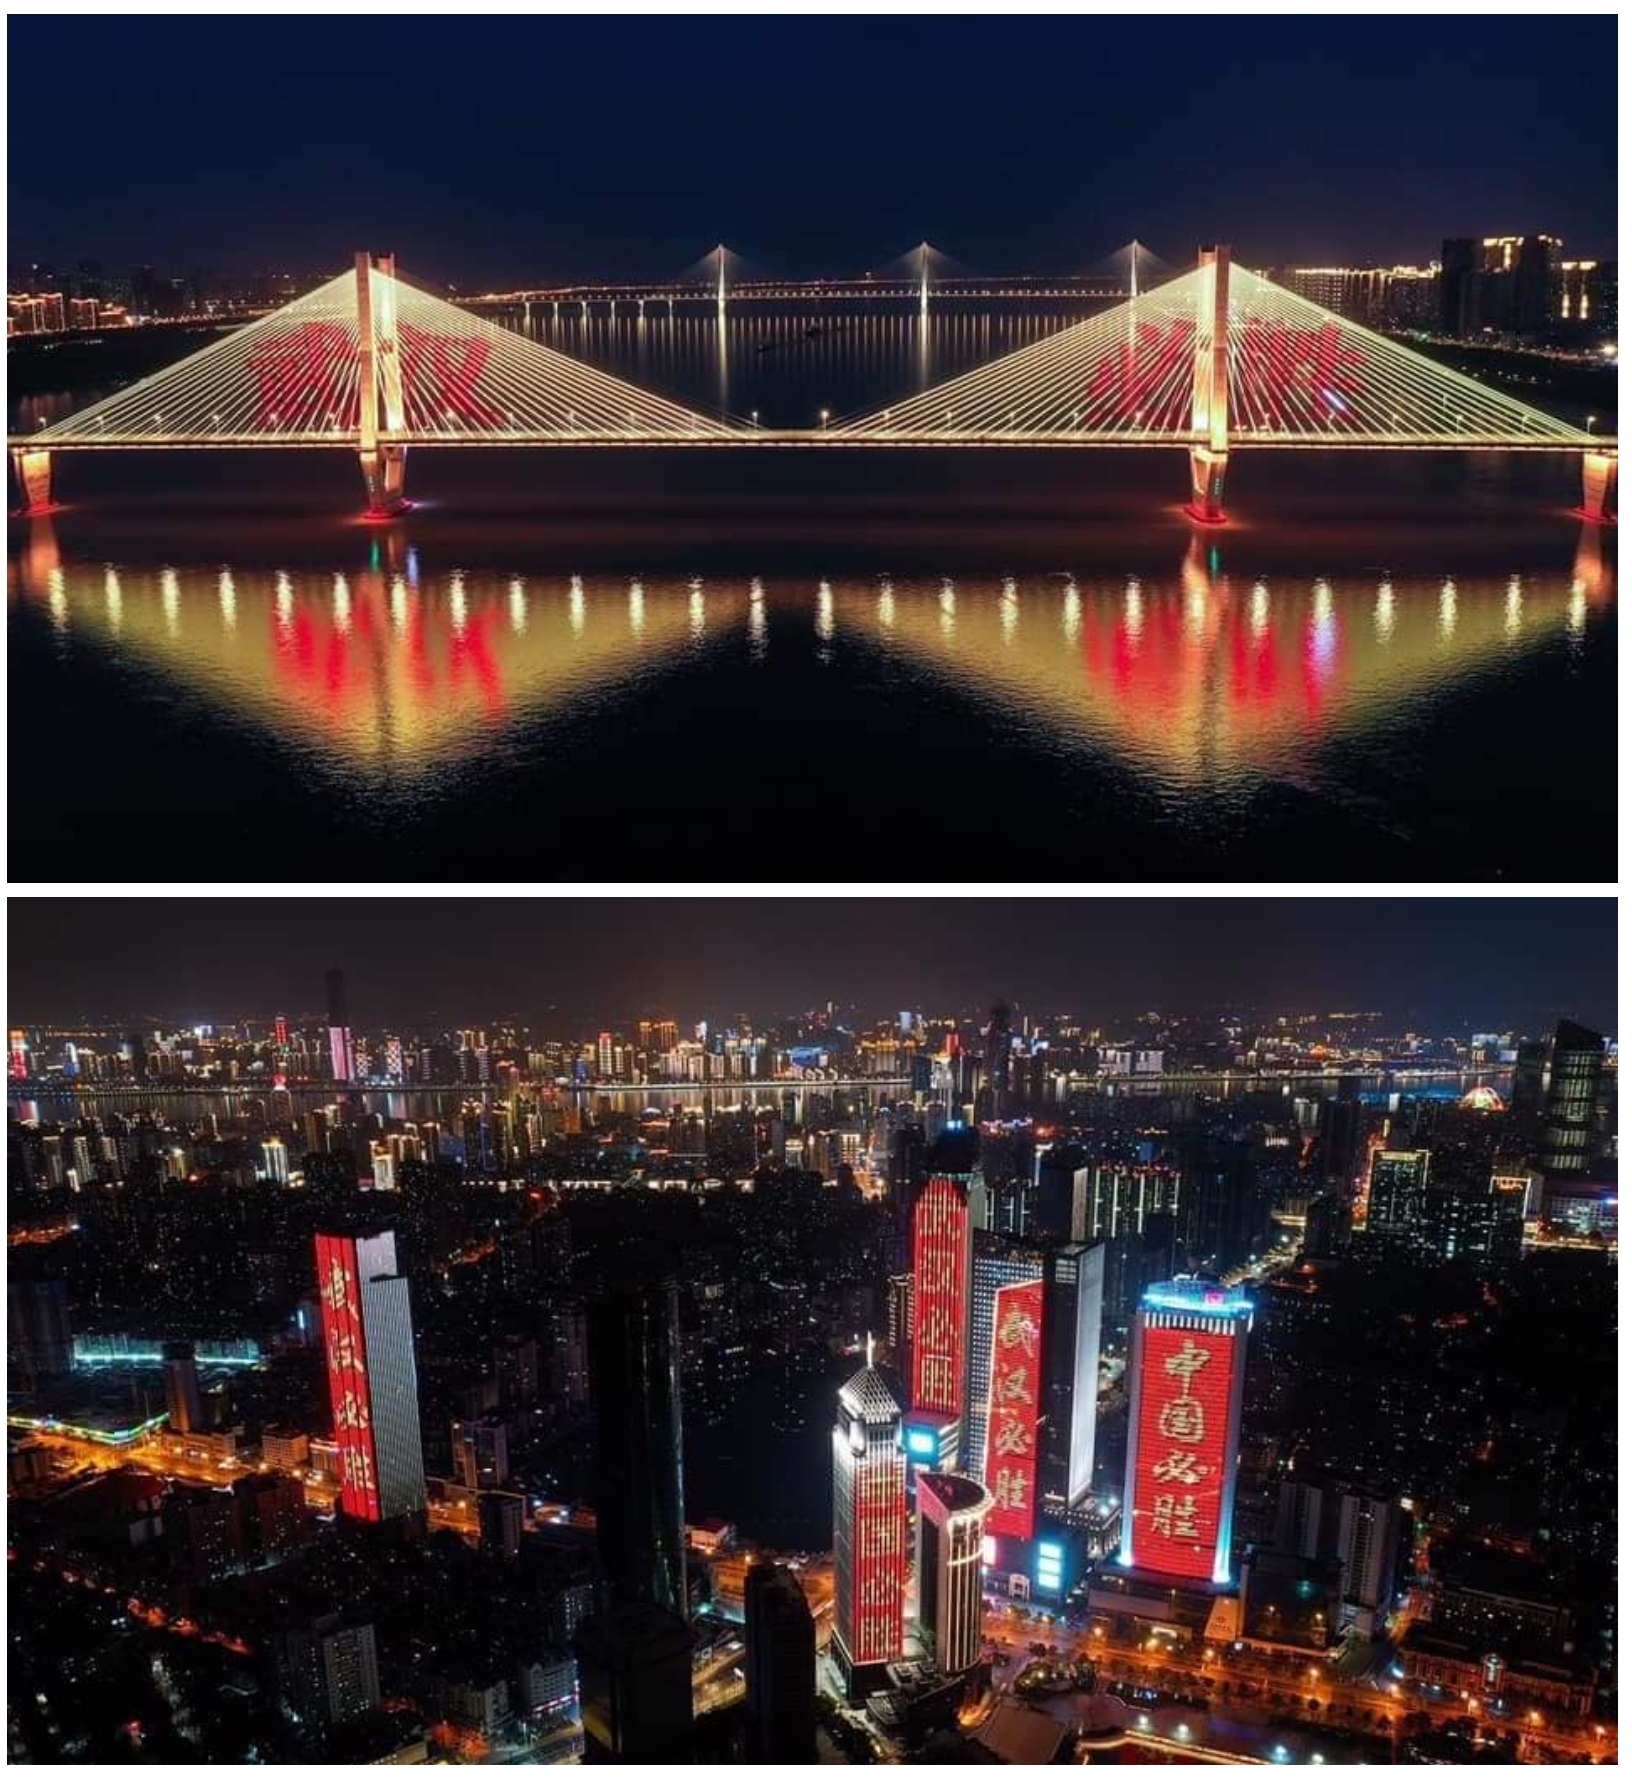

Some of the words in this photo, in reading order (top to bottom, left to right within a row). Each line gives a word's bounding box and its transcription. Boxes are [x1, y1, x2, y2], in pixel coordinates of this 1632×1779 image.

[320, 1257, 375, 1490] 武汉必胜
[995, 1303, 1036, 1510] 武汉必胜
[1151, 1339, 1215, 1538] 中国必胜
